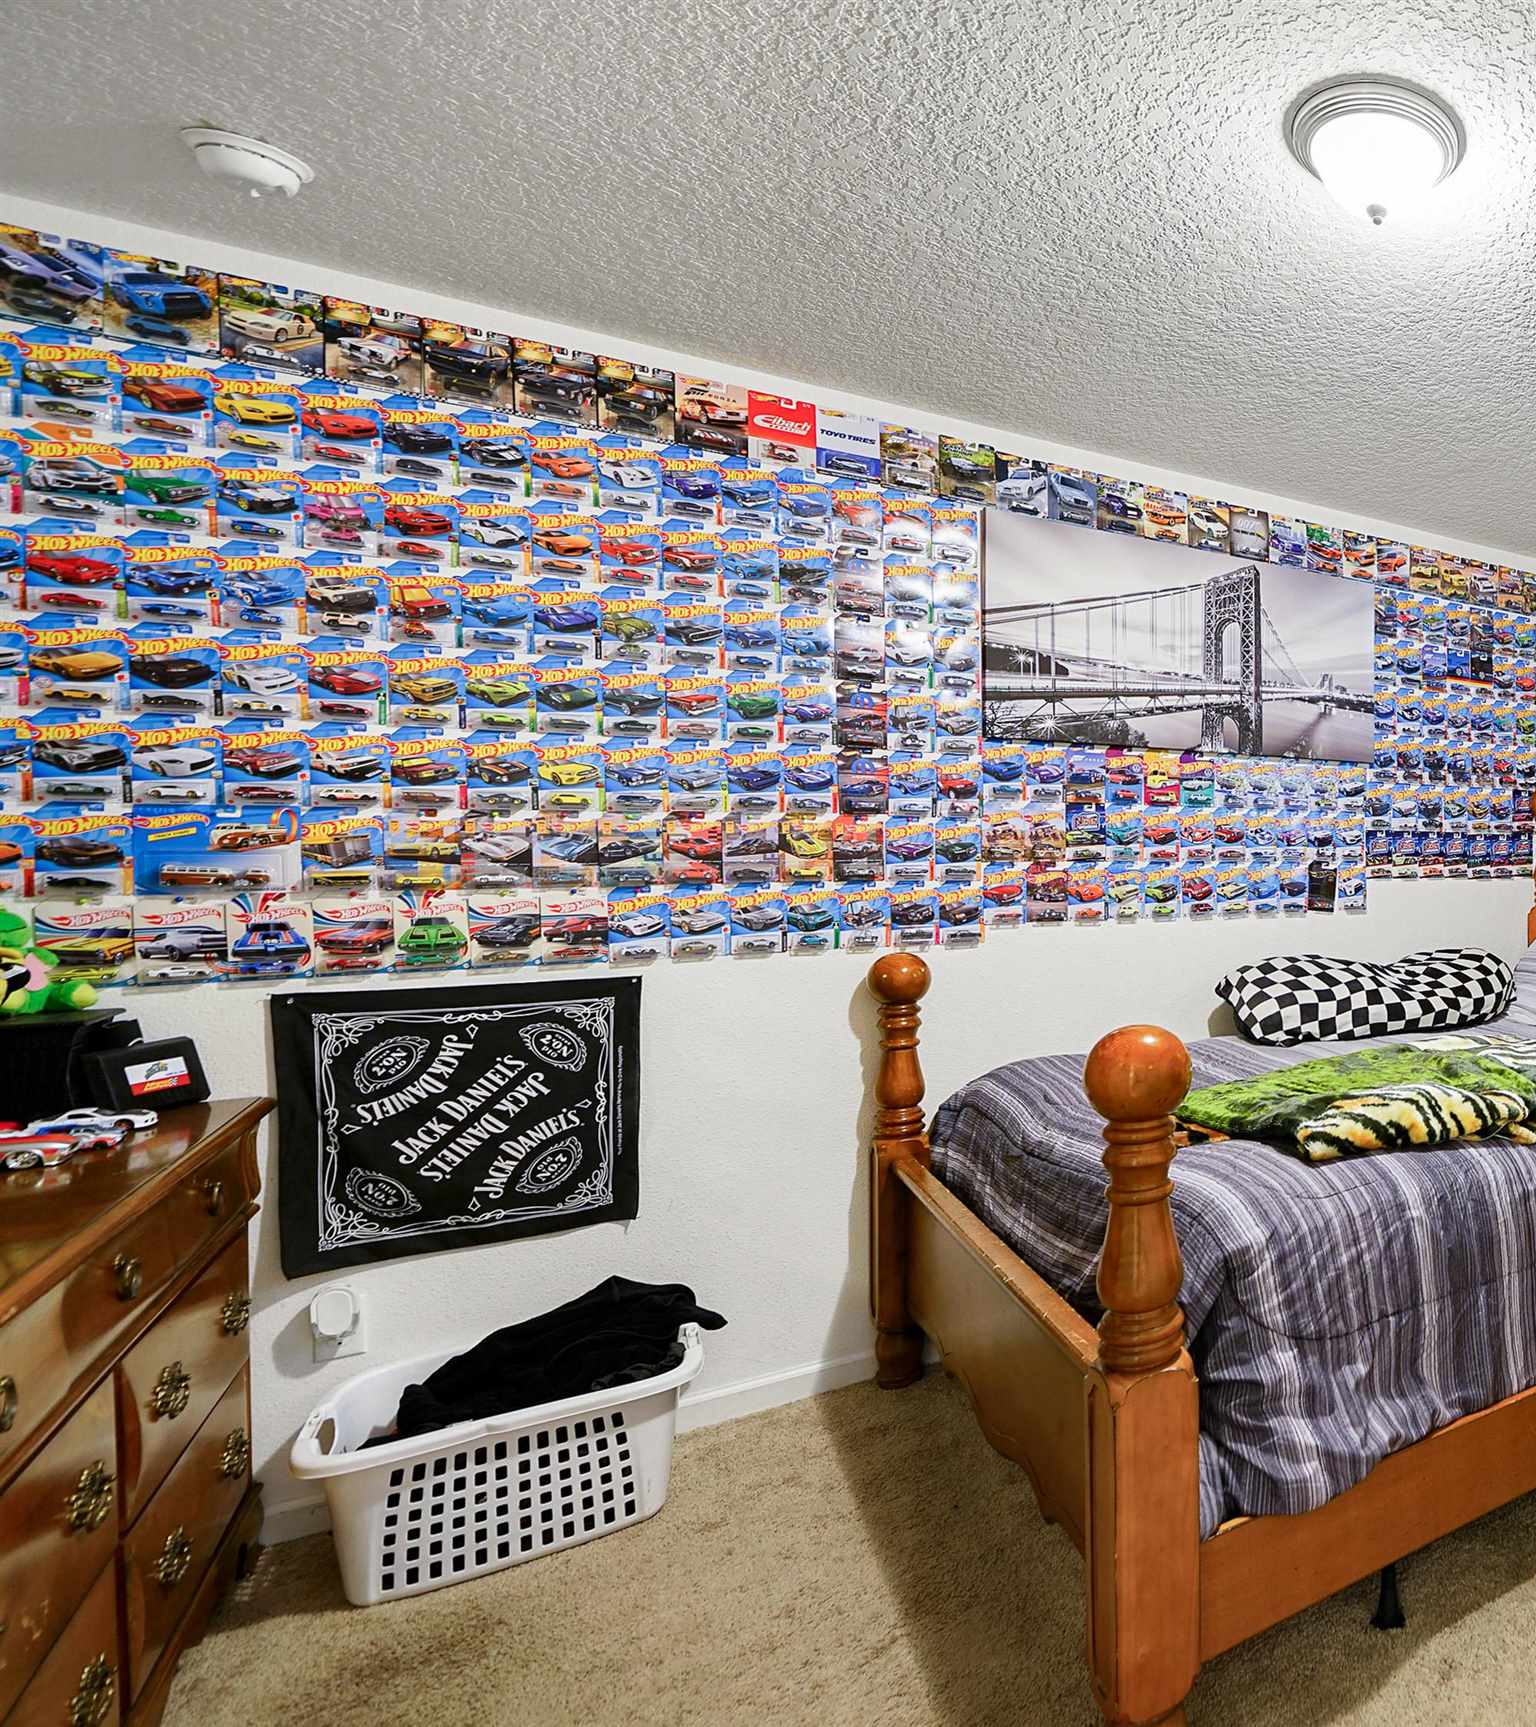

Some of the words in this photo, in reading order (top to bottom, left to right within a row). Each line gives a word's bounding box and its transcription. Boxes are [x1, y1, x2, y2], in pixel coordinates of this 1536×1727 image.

[30, 345, 64, 360] HOT
[129, 363, 161, 377] HOT
[222, 379, 251, 393] HOT
[308, 394, 335, 408] HOT
[389, 409, 415, 423] HOT
[820, 428, 846, 440] TOYO
[847, 433, 876, 445] TIRES
[31, 440, 65, 457] HOT
[131, 454, 162, 470] HOT
[310, 480, 338, 495] HOT
[390, 492, 416, 506] HOT
[465, 504, 489, 517] HOT
[35, 534, 69, 550] HOT
[133, 546, 165, 562] HOT
[225, 556, 255, 572] HOT
[36, 628, 70, 645] HOT
[136, 638, 167, 655] HOT
[228, 644, 257, 660] HOT
[314, 651, 342, 666] HOT
[395, 657, 421, 673] HOT
[470, 664, 494, 678] HOT
[39, 724, 73, 740] HOT
[139, 728, 170, 745] HOT
[231, 731, 260, 748] HOT
[317, 736, 344, 751] HOT
[397, 739, 423, 755] HOT
[472, 742, 496, 758] HOT
[42, 817, 76, 834] HOT
[308, 820, 336, 836] HOT
[426, 1034, 474, 1079] JACK
[356, 1073, 448, 1126] DANIEL'S
[493, 1072, 551, 1118] JACK
[391, 1116, 454, 1165] JACK
[437, 1055, 526, 1122] DANIEL'S
[420, 1113, 510, 1182] DANIEL'S
[473, 1156, 519, 1199] JACK
[499, 1108, 580, 1160] DANIEL'S
